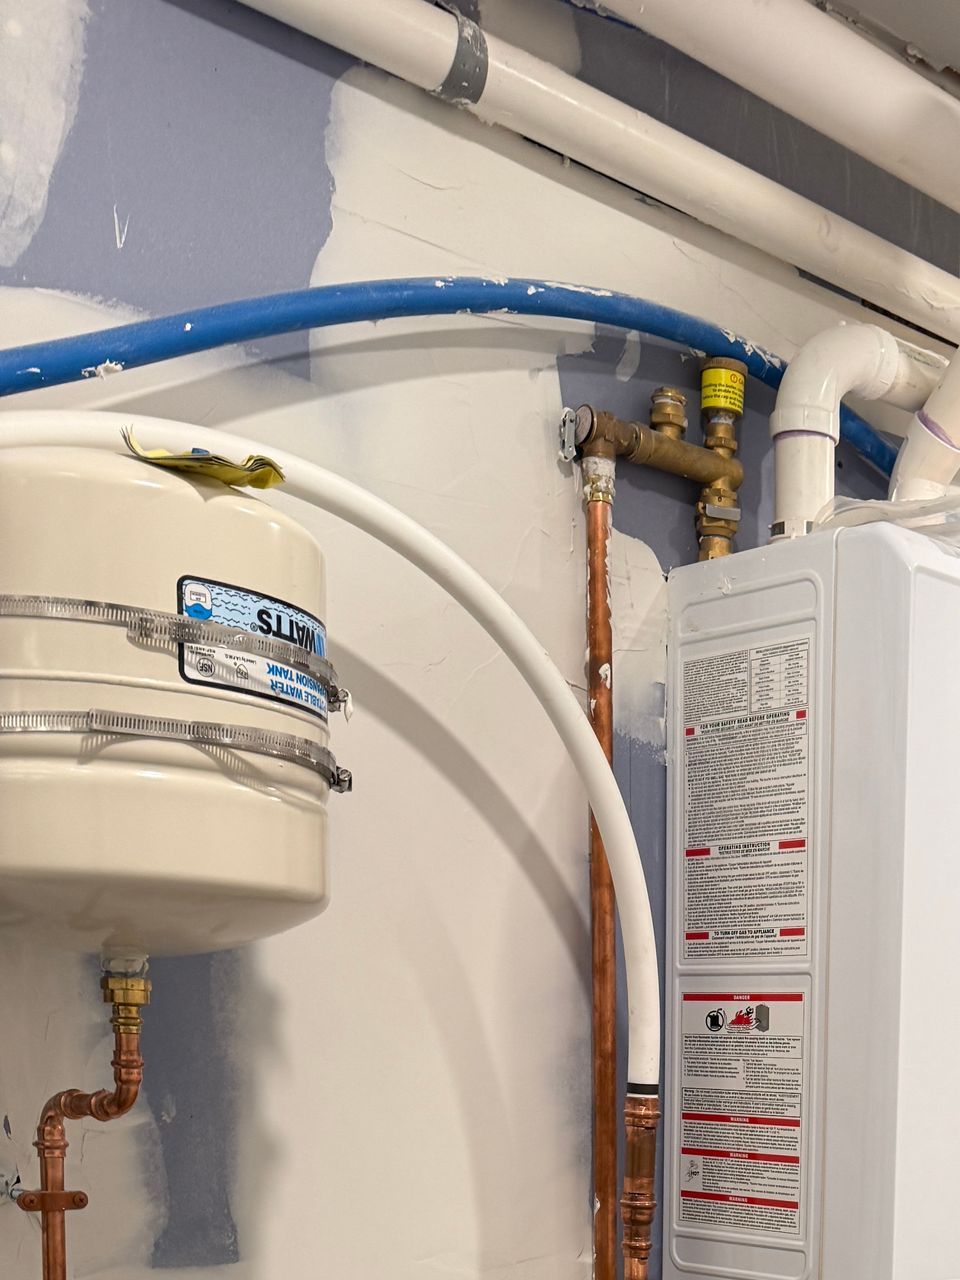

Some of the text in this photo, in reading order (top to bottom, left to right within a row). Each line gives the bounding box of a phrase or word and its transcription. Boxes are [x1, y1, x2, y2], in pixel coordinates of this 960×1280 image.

[257, 609, 316, 653] WATTS
[199, 661, 213, 673] NSF
[266, 662, 294, 680] TANK
[270, 679, 303, 700] WATER
[709, 721, 720, 729] YOUR
[721, 719, 736, 727] SAFETY
[749, 715, 765, 723] BEFORE
[766, 711, 790, 721] OPERATING
